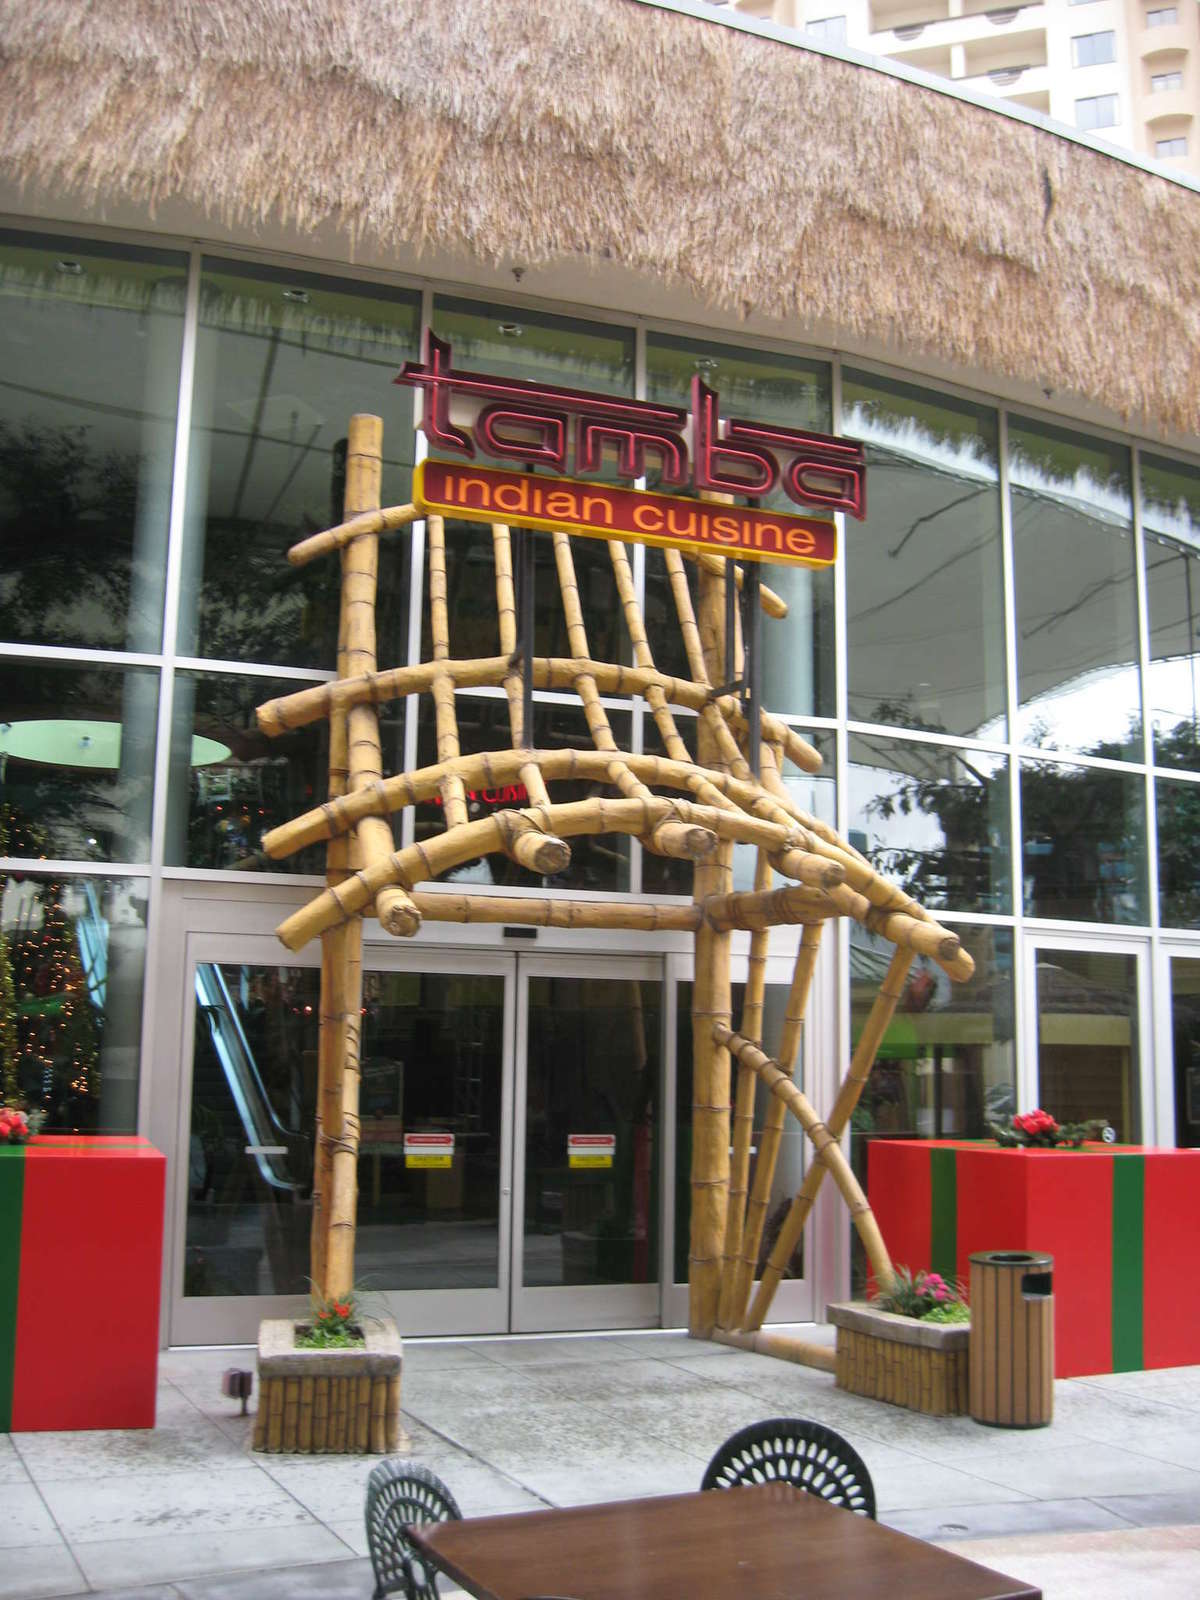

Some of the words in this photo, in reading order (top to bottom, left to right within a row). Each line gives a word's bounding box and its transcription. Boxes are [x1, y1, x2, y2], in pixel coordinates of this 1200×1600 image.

[393, 327, 867, 521] tamba
[444, 475, 614, 525] indian
[632, 504, 817, 554] cuisine
